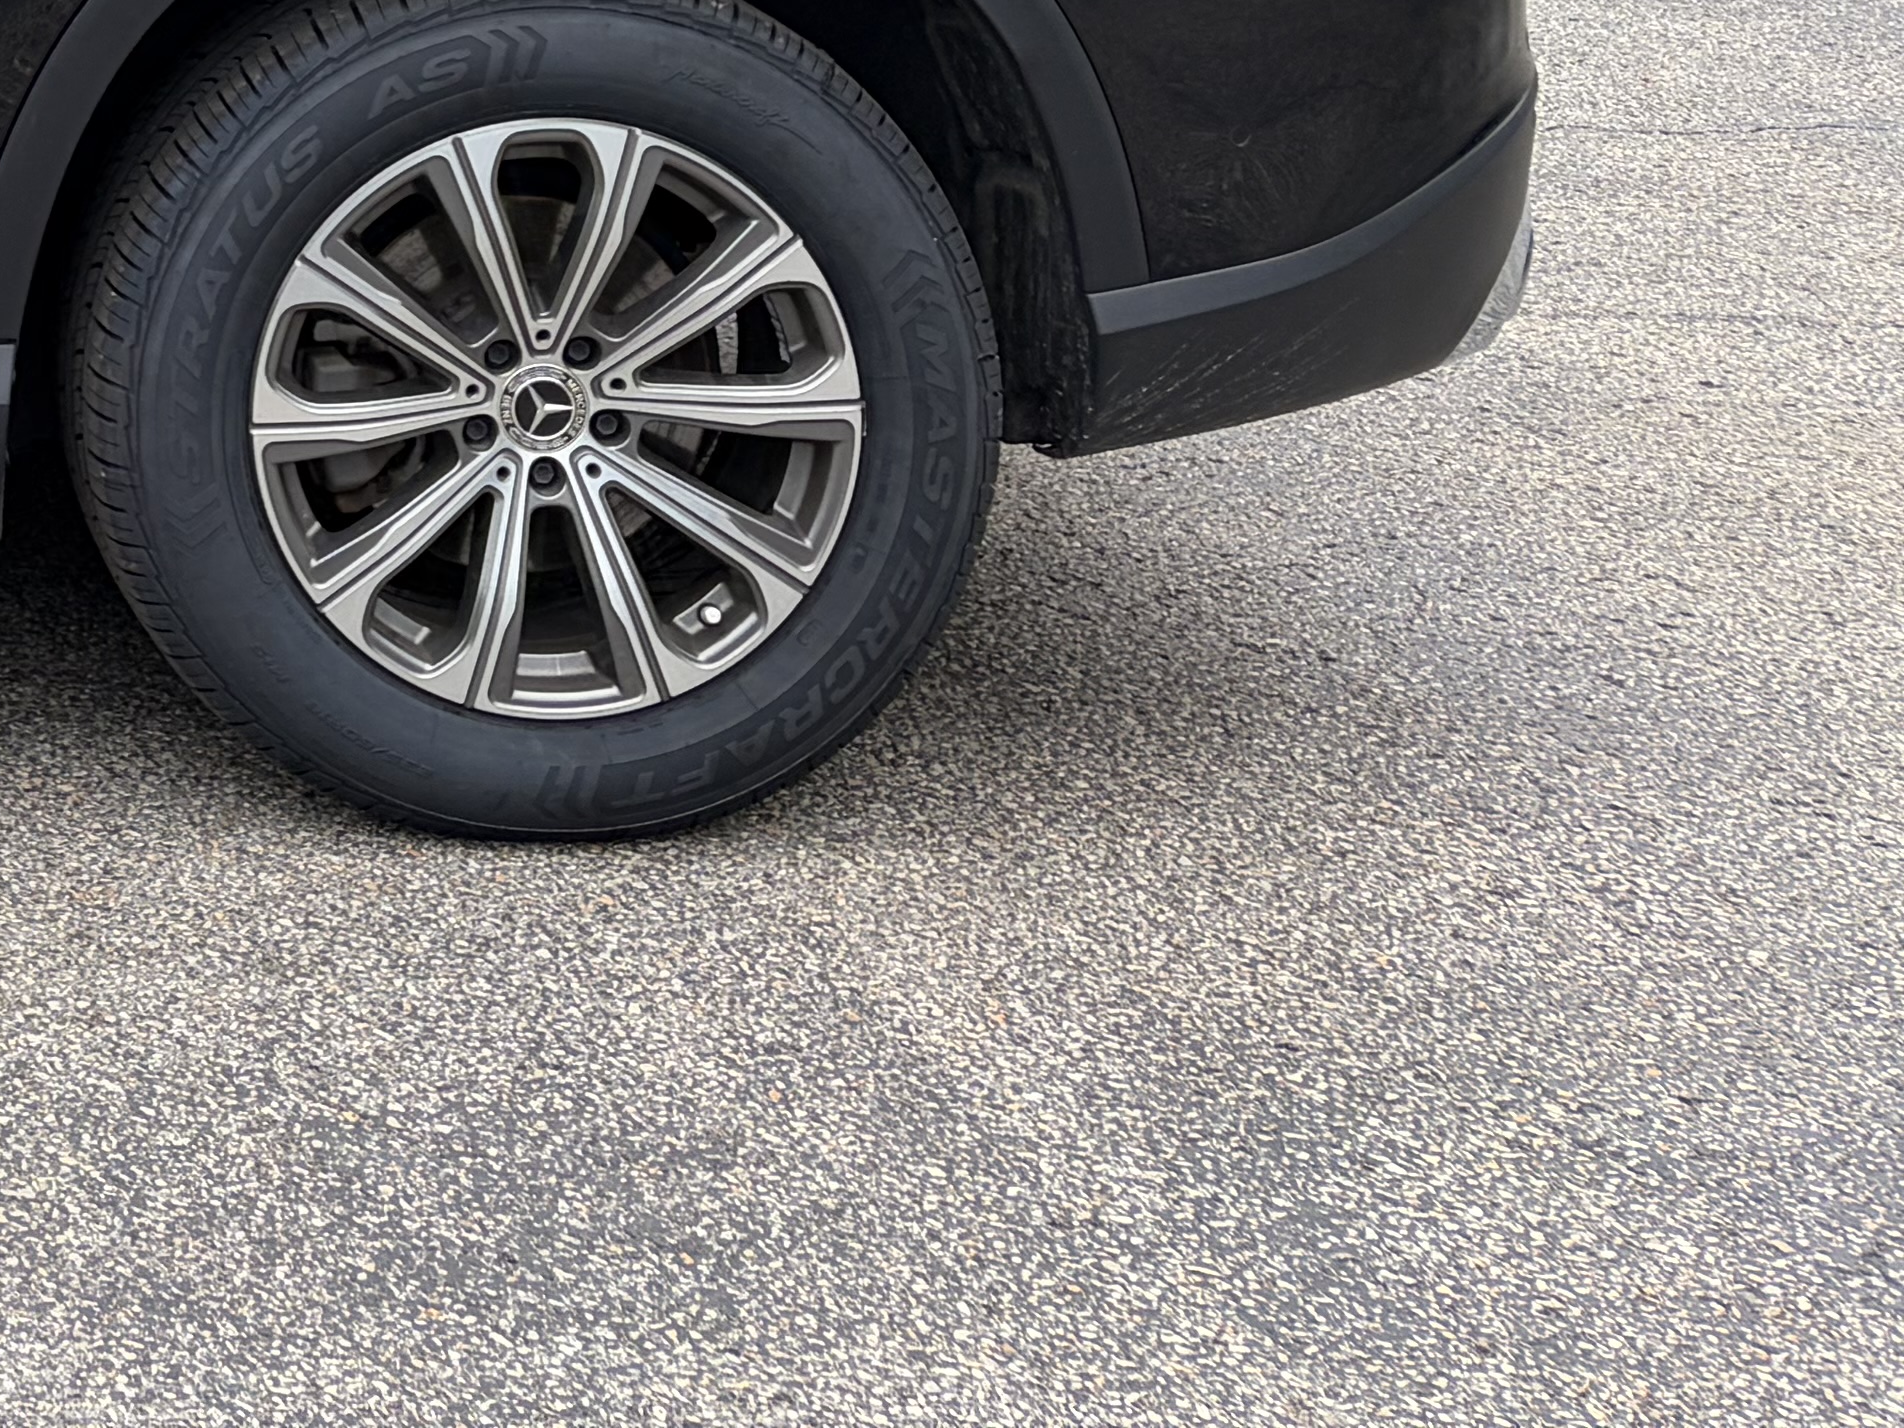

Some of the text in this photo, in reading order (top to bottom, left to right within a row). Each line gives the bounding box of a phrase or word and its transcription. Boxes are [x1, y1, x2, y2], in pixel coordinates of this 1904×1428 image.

[166, 46, 473, 486] STRATUS AS
[610, 321, 959, 809] MASTERCRAFT
